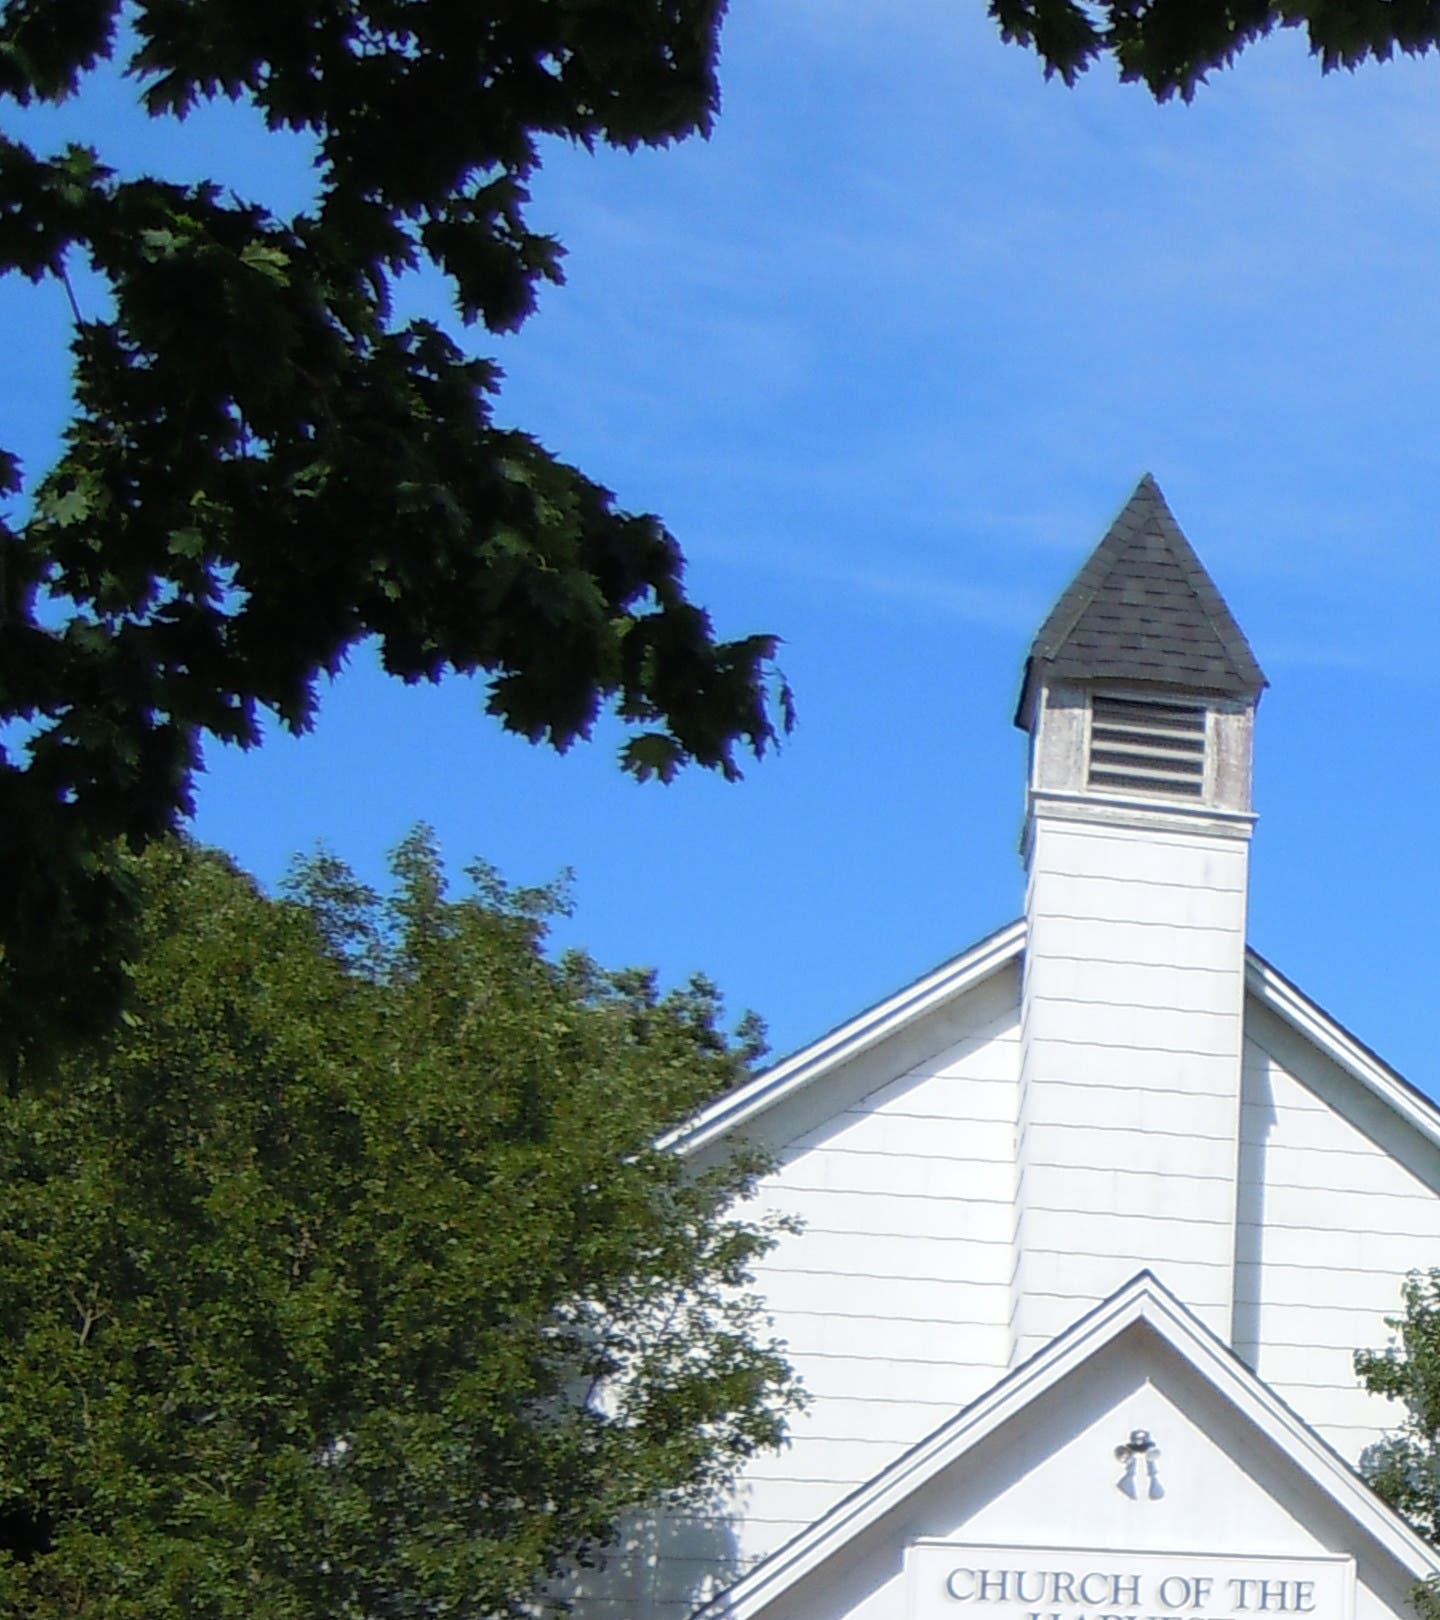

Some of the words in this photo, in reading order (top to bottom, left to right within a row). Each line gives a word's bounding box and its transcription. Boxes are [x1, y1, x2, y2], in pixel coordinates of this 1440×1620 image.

[946, 1567, 1141, 1606] CHURCH
[1159, 1575, 1214, 1609] OF
[1228, 1578, 1316, 1613] THE
